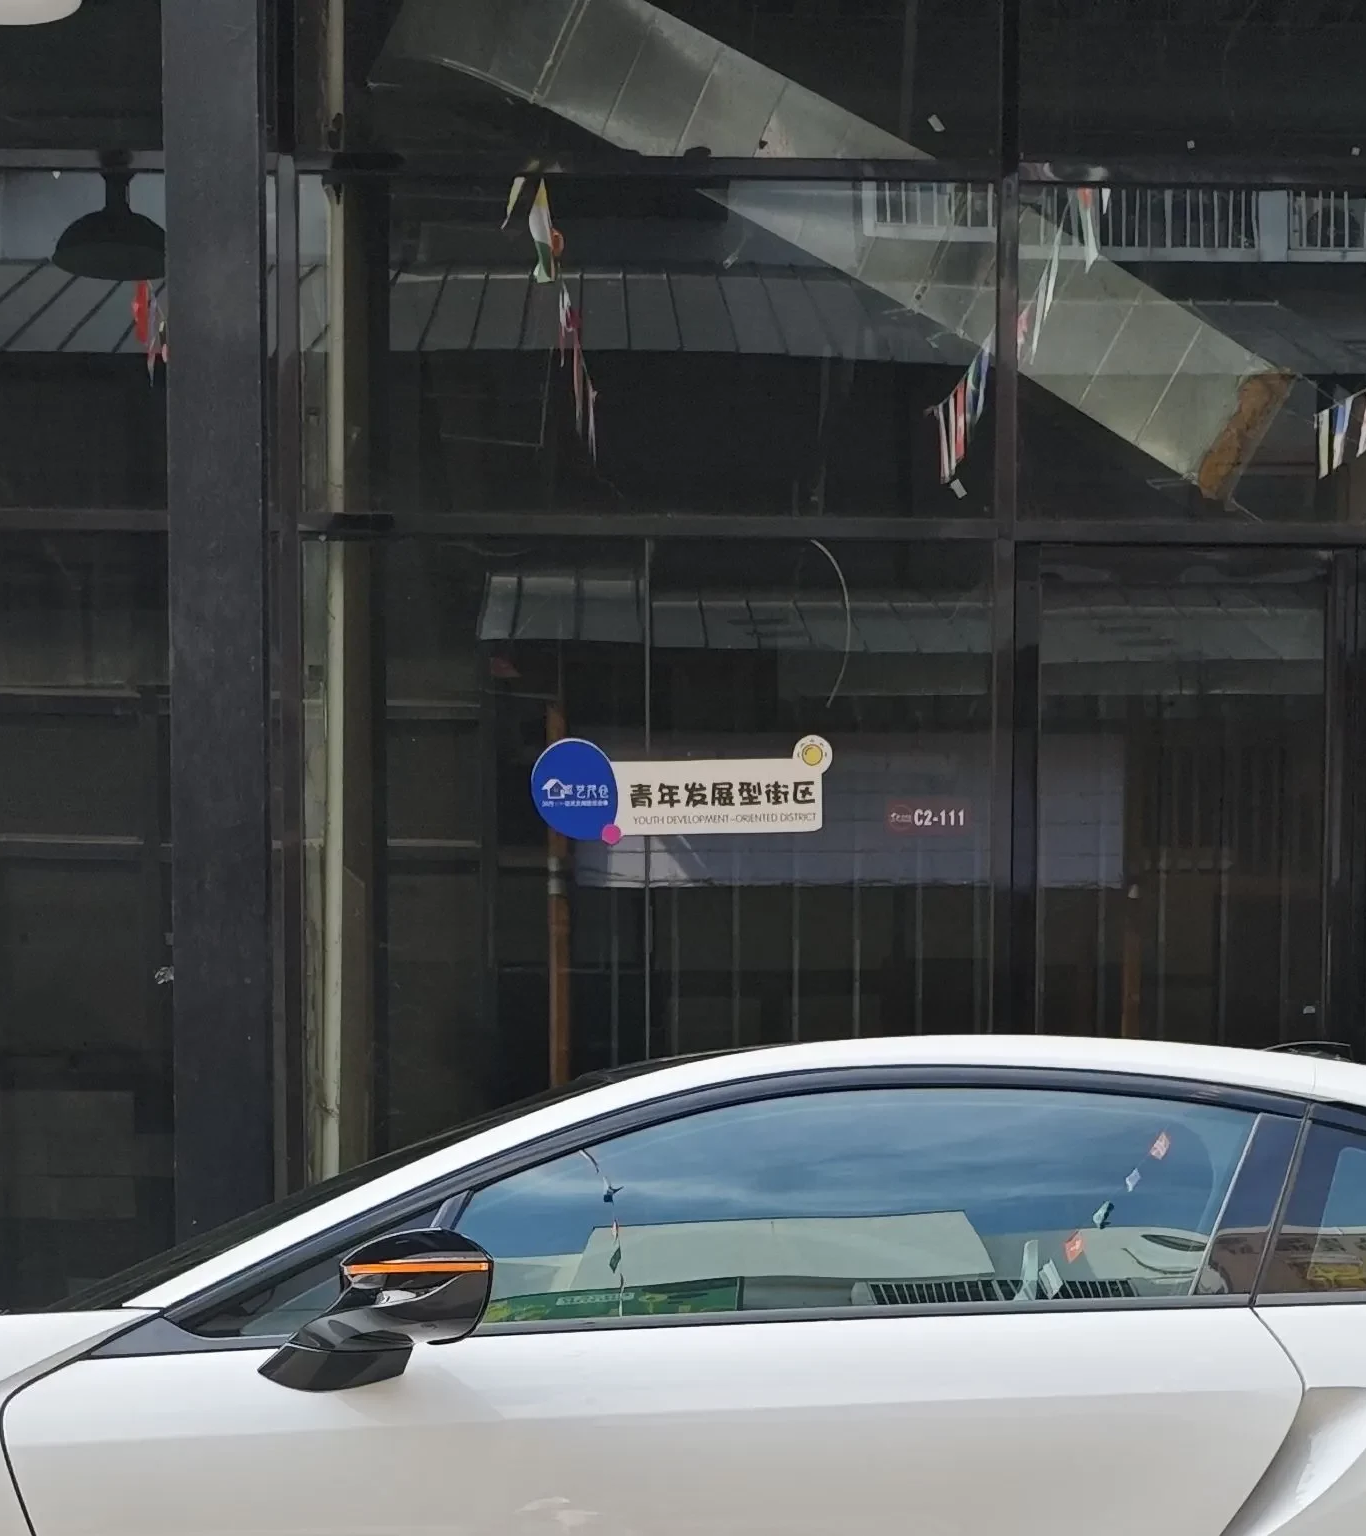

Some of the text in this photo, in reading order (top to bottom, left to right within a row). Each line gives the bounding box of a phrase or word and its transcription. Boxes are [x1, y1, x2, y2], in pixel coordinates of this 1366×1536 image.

[630, 781, 816, 808] 青年发展型街区
[633, 815, 665, 825] YOUTH
[779, 812, 817, 823] DISTRICT
[914, 808, 964, 826] C2-111
